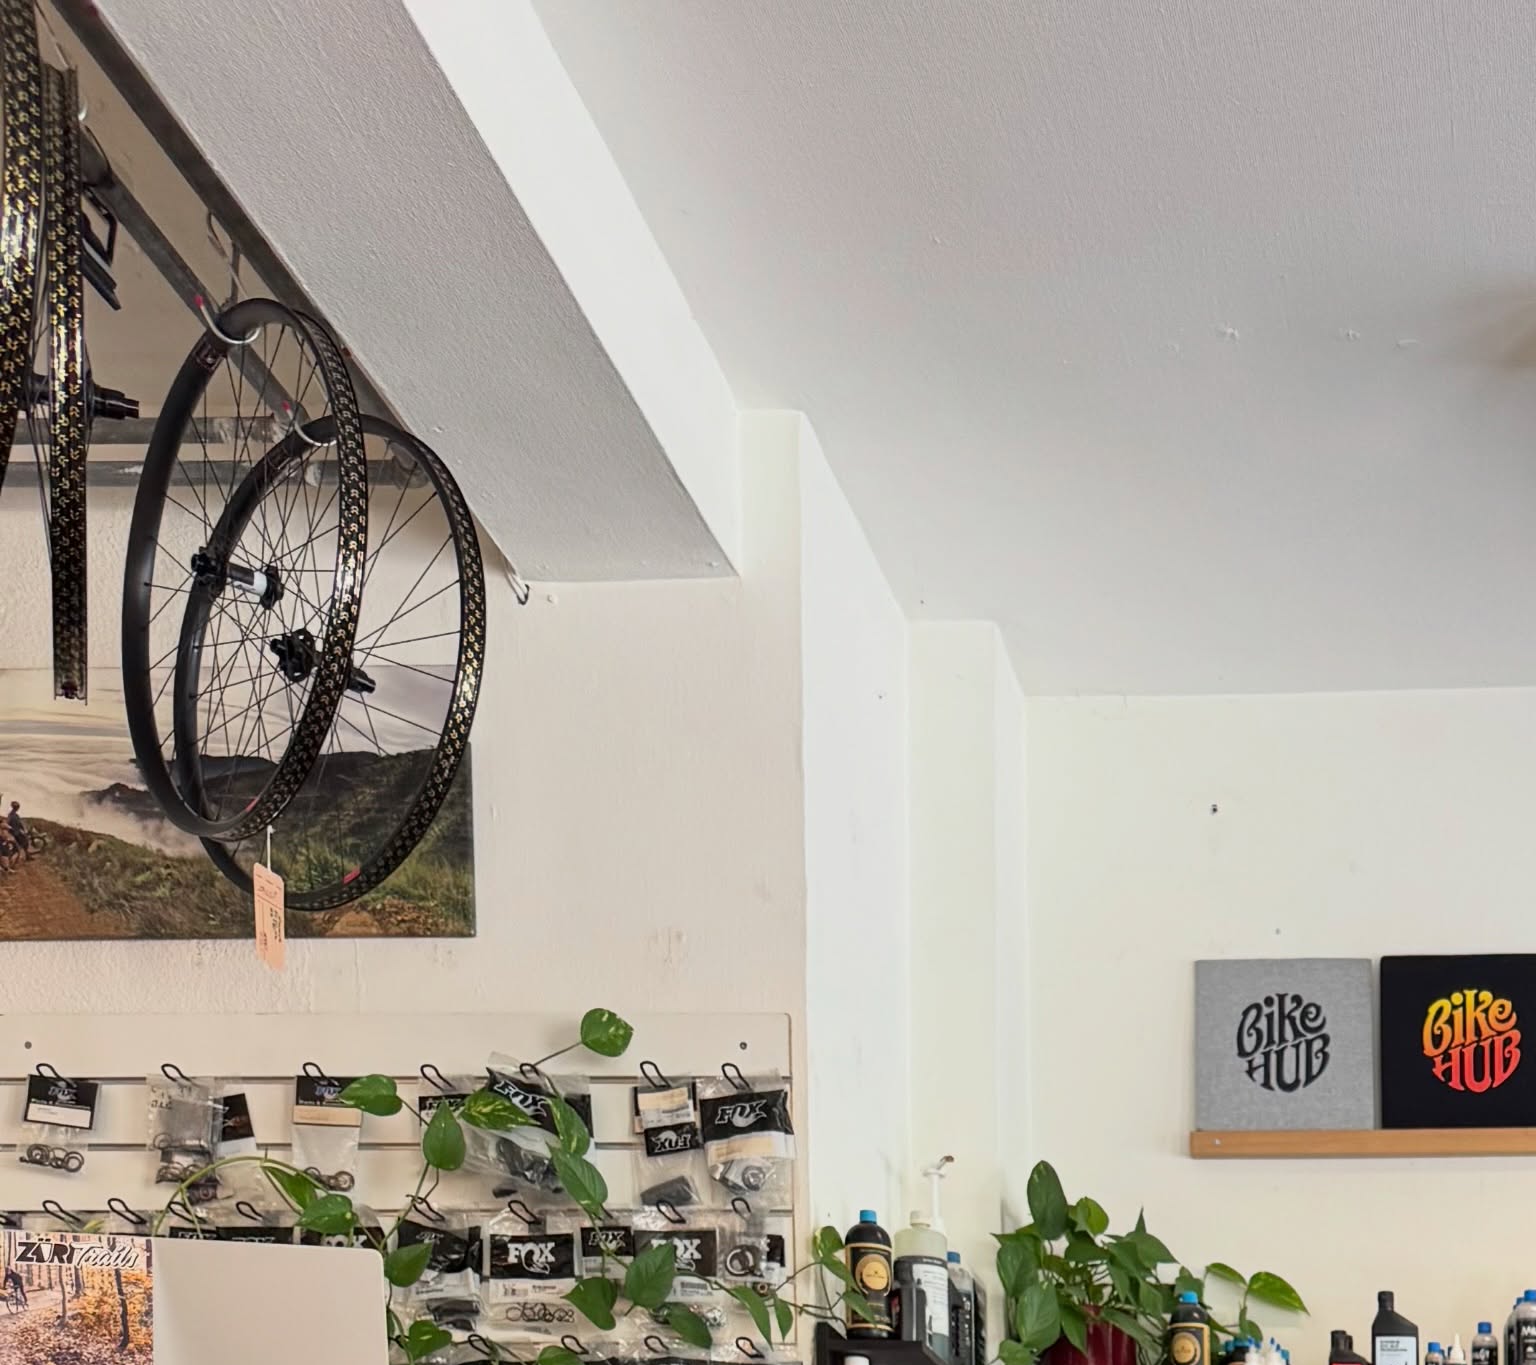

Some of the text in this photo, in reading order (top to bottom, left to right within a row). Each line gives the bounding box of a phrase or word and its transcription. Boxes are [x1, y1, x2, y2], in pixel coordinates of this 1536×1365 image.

[1236, 993, 1327, 1058] Bike
[1422, 988, 1518, 1057] Bike
[1246, 1032, 1331, 1093] HUB
[1432, 1029, 1522, 1094] HUB
[494, 1080, 549, 1118] FOX
[715, 1100, 768, 1128] FOX
[508, 1242, 556, 1272] FOX
